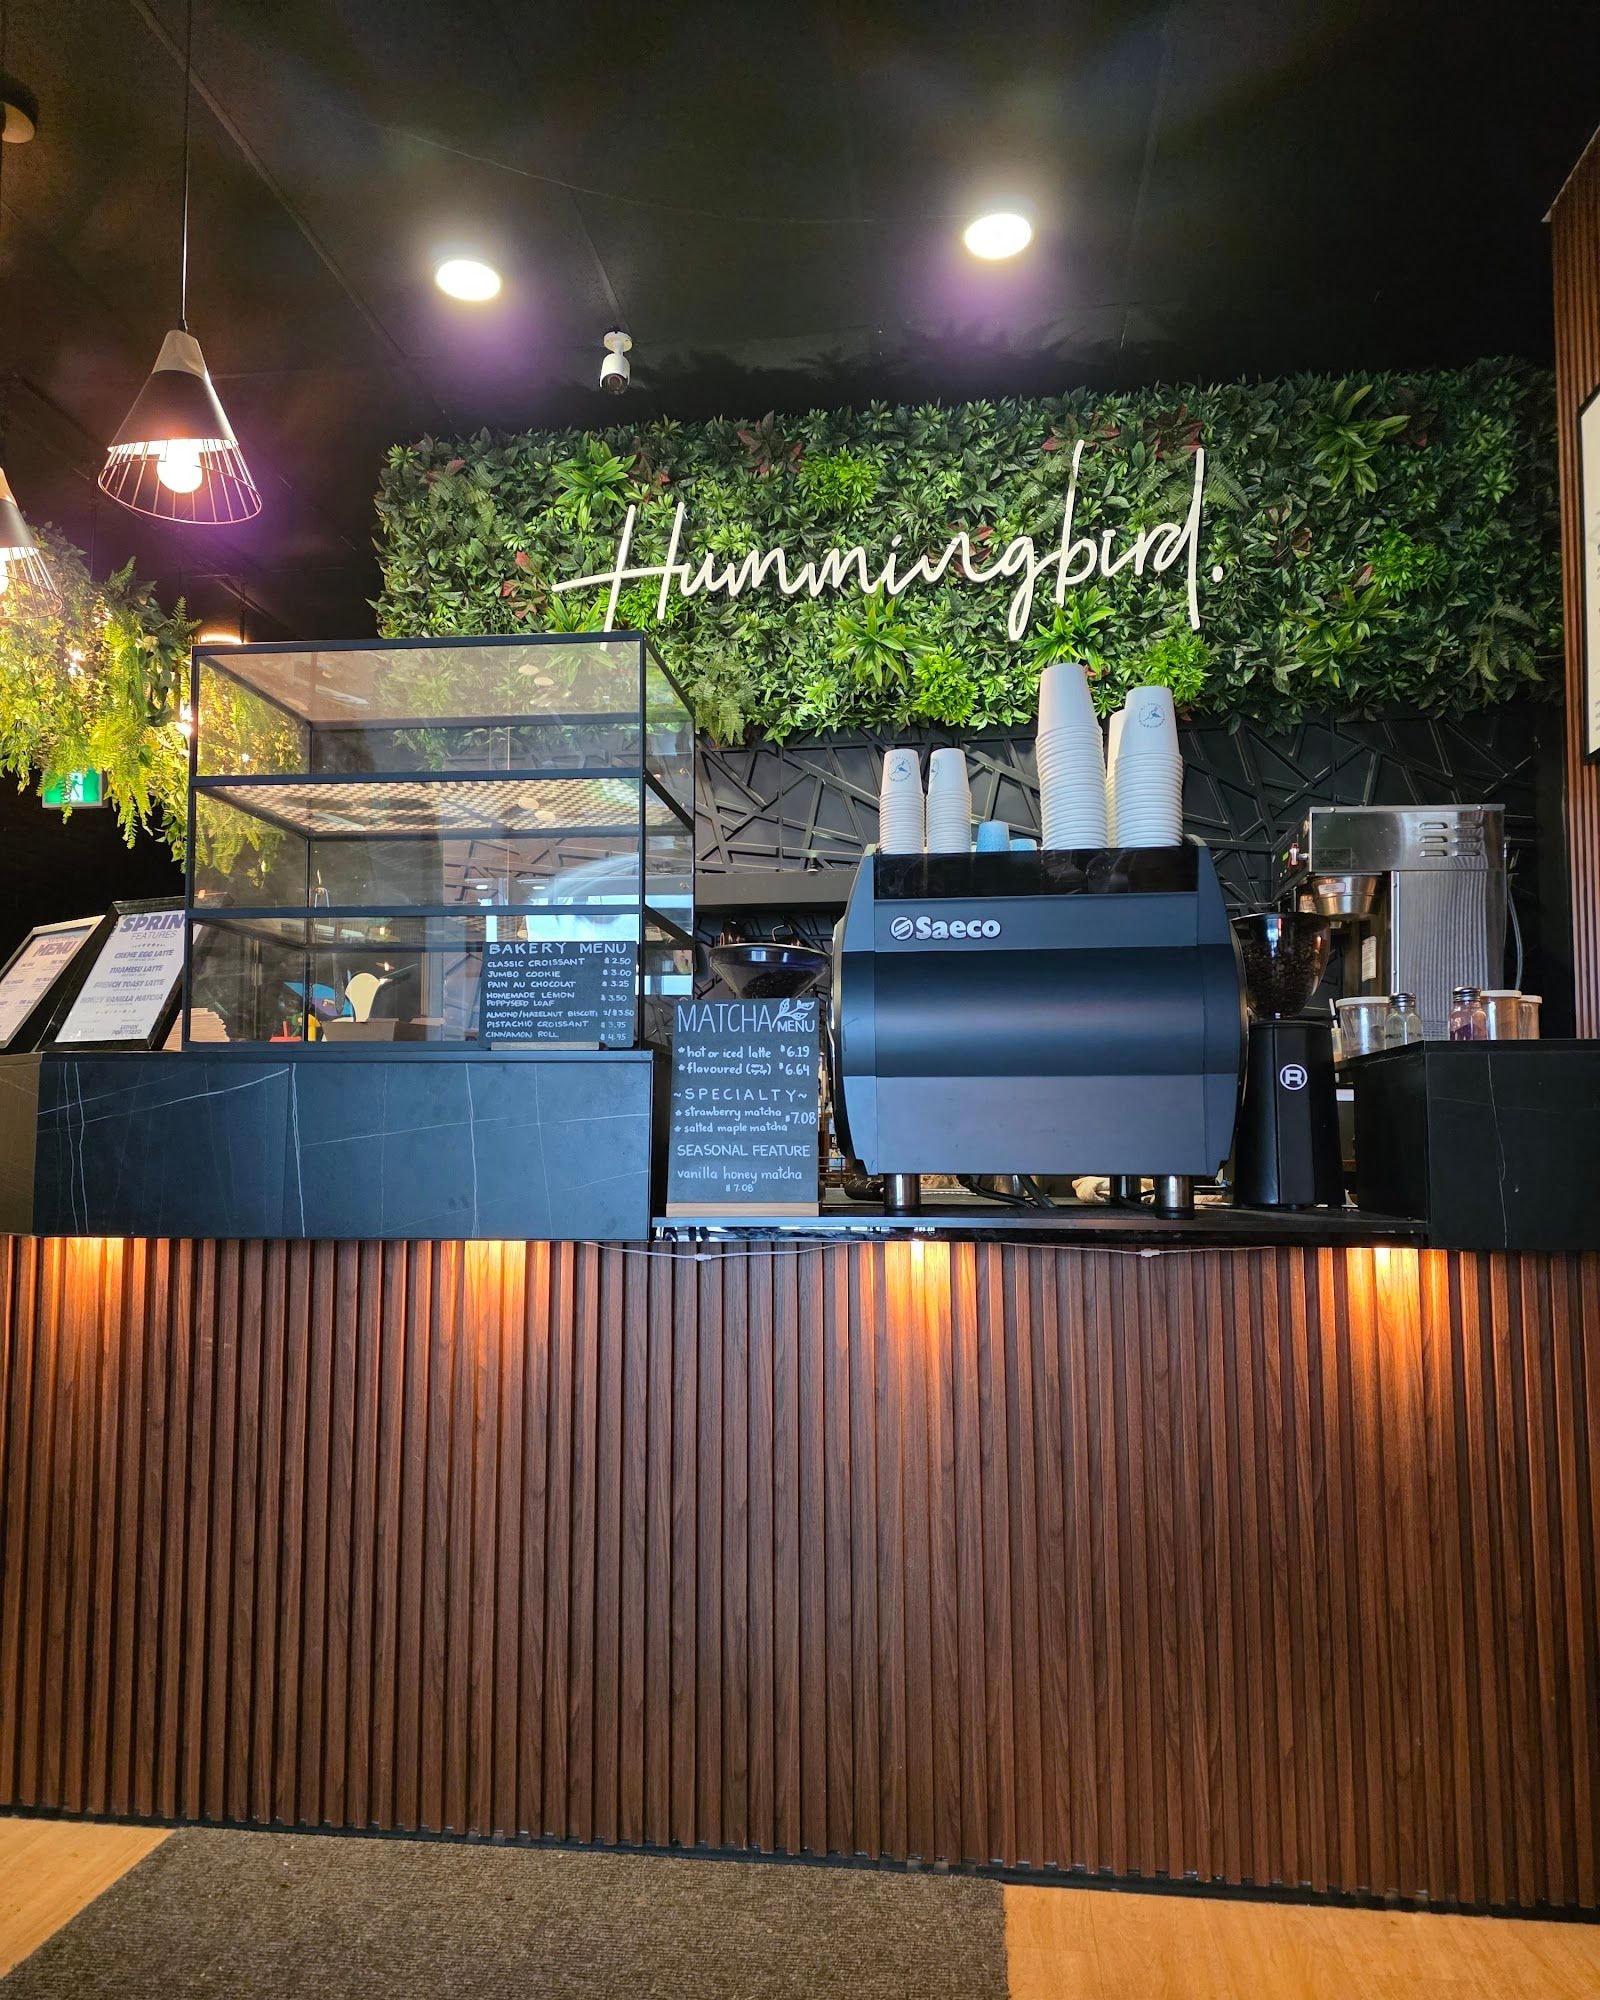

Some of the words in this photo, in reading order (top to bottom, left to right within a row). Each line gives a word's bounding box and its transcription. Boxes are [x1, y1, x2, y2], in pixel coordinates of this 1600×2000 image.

[119, 914, 186, 932] SPRIN
[915, 916, 1001, 940] Saeco
[131, 930, 178, 940] FEATURES
[33, 941, 78, 957] MENU
[154, 949, 174, 957] LATTE
[489, 942, 567, 955] BAKERY
[579, 943, 627, 954] MENU
[143, 964, 163, 972] LATTE
[487, 960, 524, 968] CLASSIC
[528, 957, 585, 967] CROISSANT
[487, 970, 519, 978] JUMBO
[486, 999, 529, 1007] POPPYSEED
[487, 1020, 533, 1028] PISTACHIO
[537, 1020, 589, 1028] CROISSANT
[677, 1003, 773, 1033] MATCHA
[777, 1019, 816, 1033] MENU
[485, 1030, 533, 1038] CINNAMON
[537, 1030, 560, 1038] ROLL
[687, 1045, 707, 1058] hot
[707, 1050, 720, 1058] or
[722, 1046, 744, 1059] iced
[748, 1045, 772, 1058] latte
[780, 1044, 810, 1058] $6.19
[686, 1062, 742, 1075] flavoured
[778, 1062, 810, 1076] $6.64
[684, 1105, 741, 1121] strawberry
[744, 1107, 782, 1117] matcha
[785, 1111, 817, 1125] $7.08
[684, 1122, 713, 1133] salted
[717, 1122, 747, 1135] maple
[749, 1121, 788, 1132] matcha
[677, 1144, 749, 1156] SEASONAL
[752, 1144, 811, 1157] FEATURE
[677, 1166, 718, 1179] vanilla
[723, 1165, 757, 1184] honey
[761, 1166, 803, 1180] matcha
